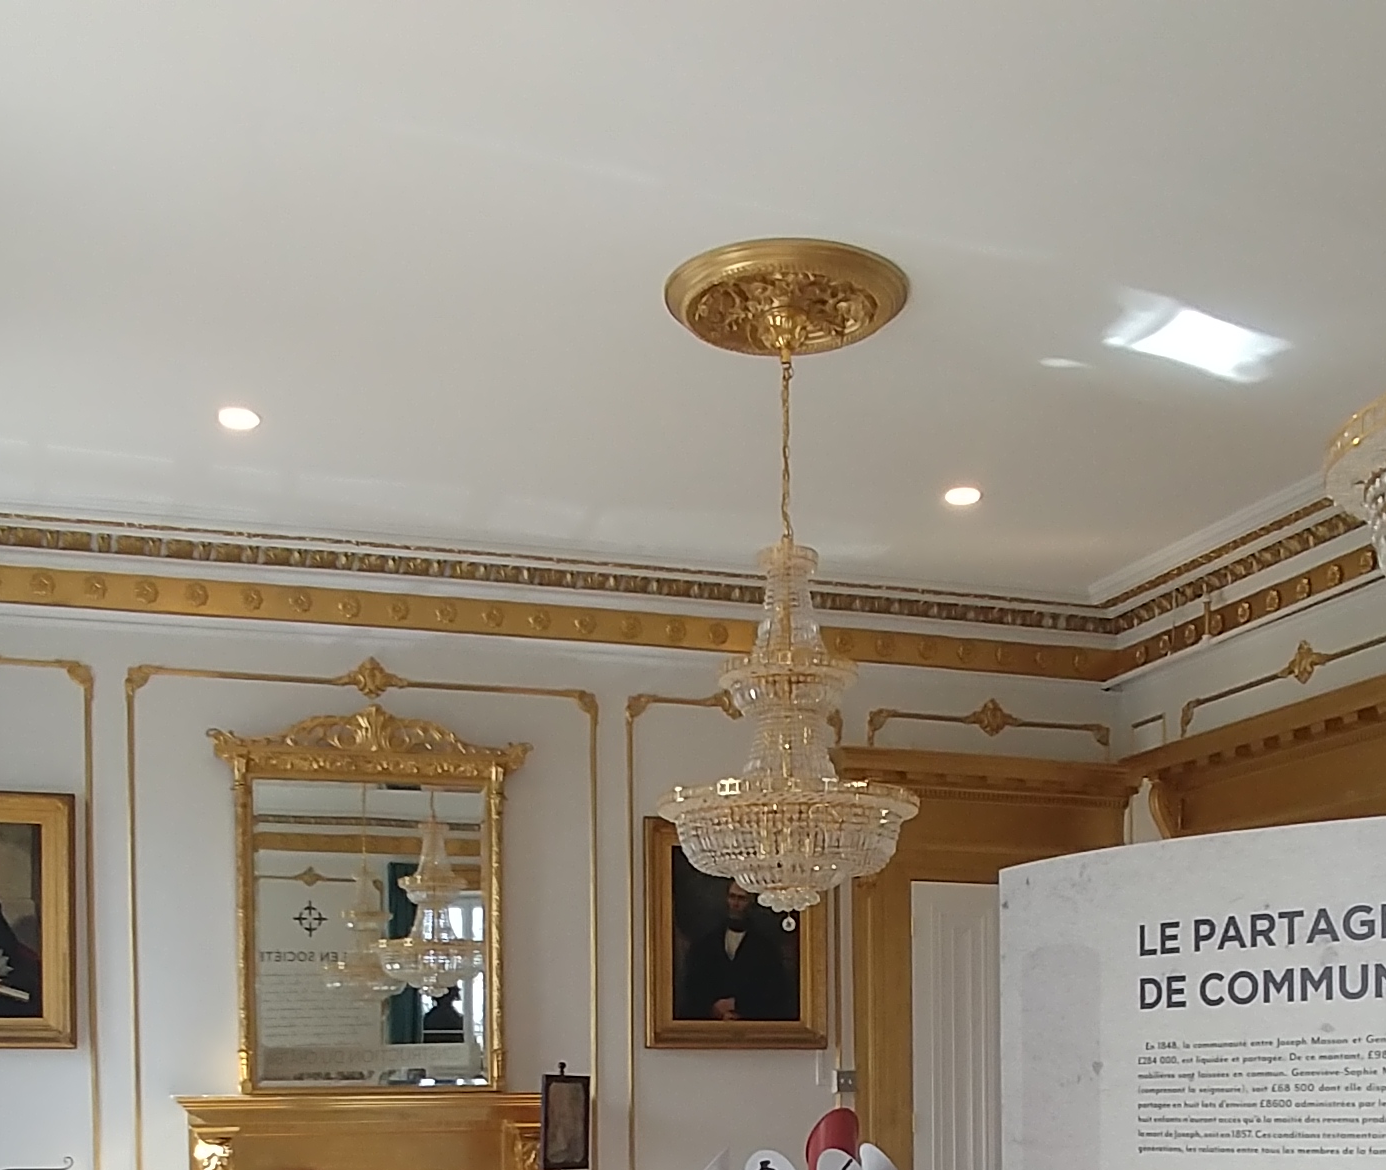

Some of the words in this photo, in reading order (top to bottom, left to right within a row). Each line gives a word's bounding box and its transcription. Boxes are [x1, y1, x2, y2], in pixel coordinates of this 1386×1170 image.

[1138, 921, 1182, 957] LE
[1139, 975, 1187, 1010] DE
[1289, 1052, 1303, 1061] De
[1272, 1084, 1291, 1092] £68
[1294, 1083, 1315, 1092] 500
[1260, 1099, 1293, 1108] £8600
